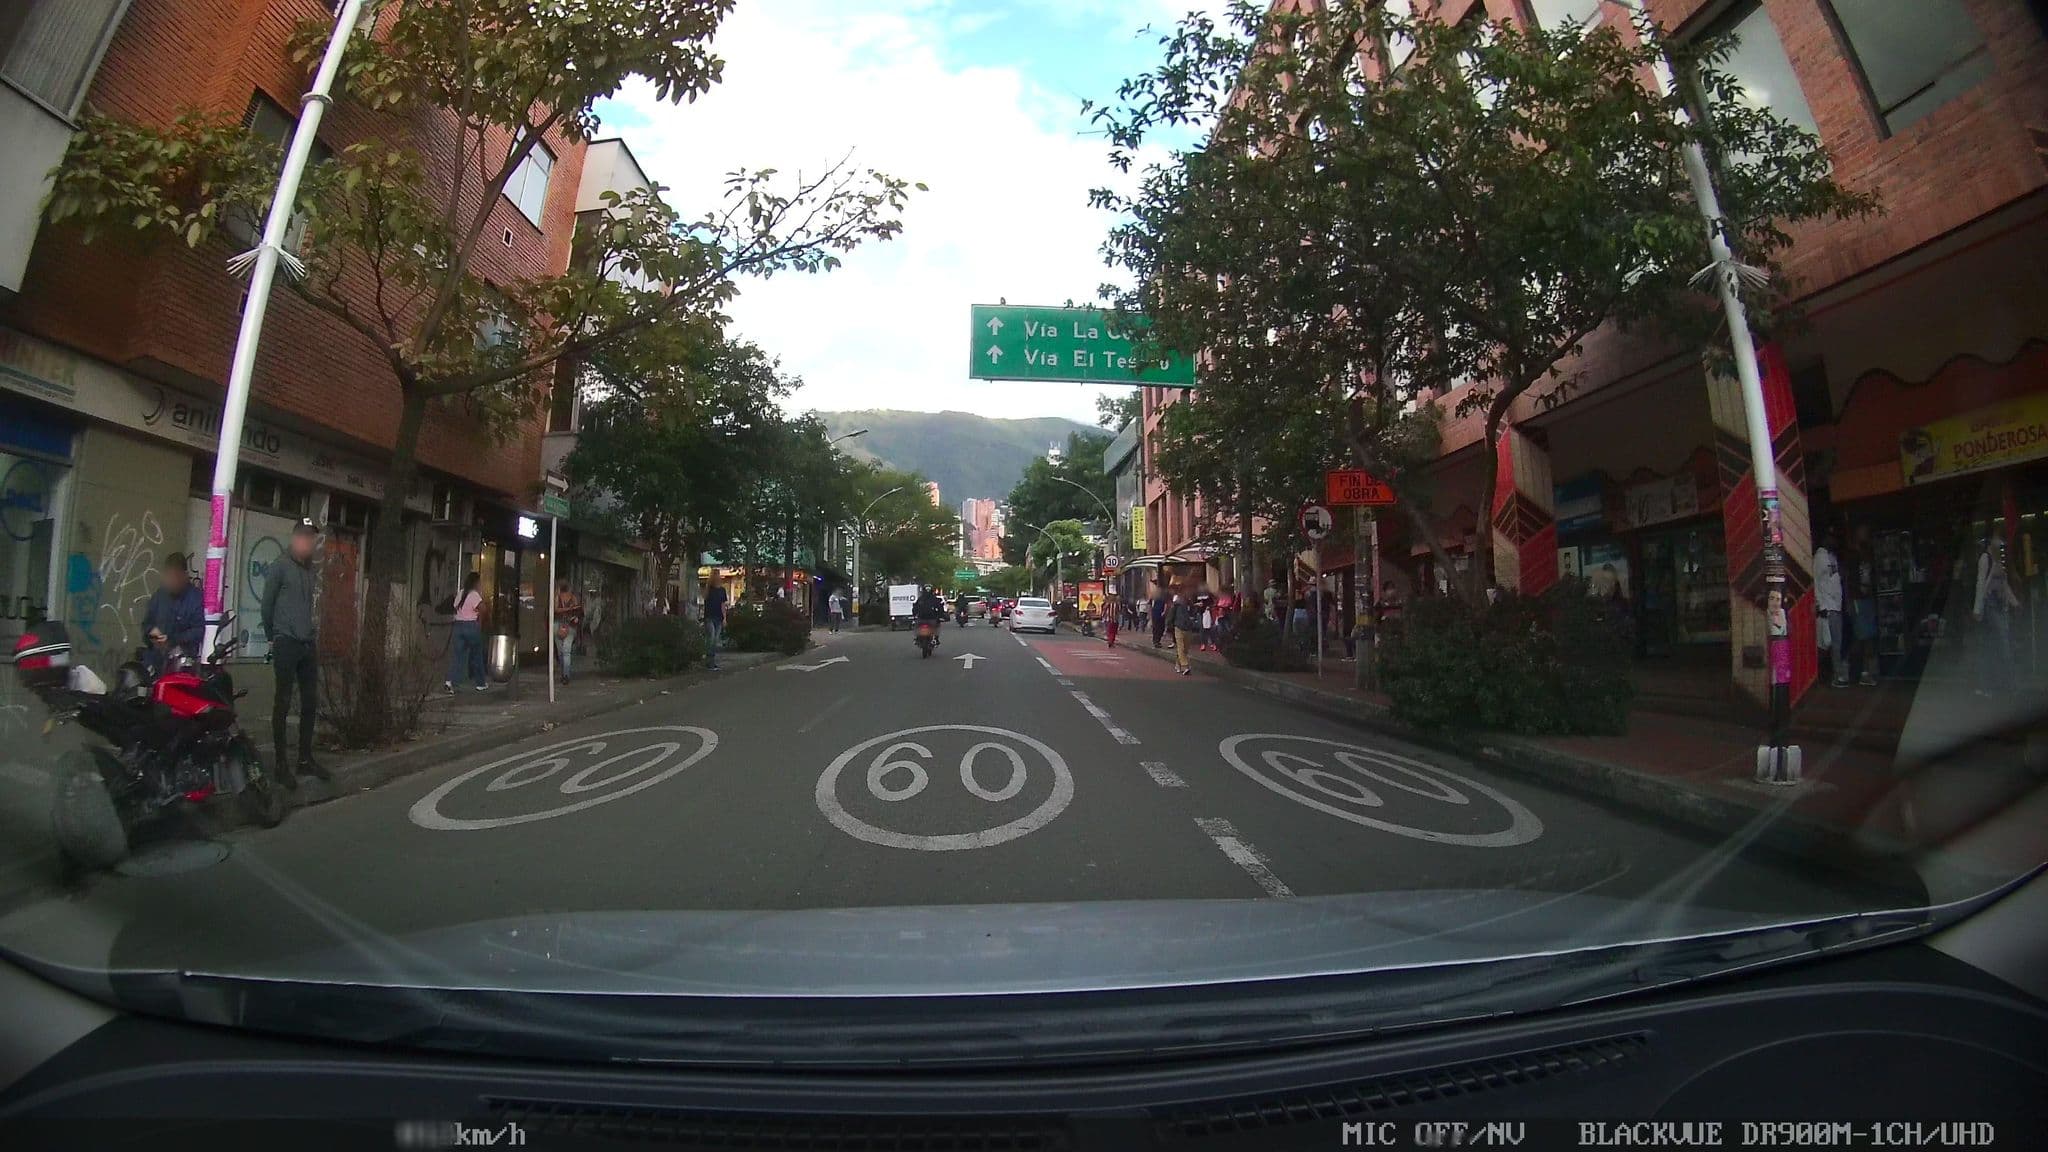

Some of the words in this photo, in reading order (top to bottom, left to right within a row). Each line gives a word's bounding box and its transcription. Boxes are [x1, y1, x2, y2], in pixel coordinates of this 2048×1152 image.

[1024, 320, 1058, 338] Vía
[1073, 321, 1099, 339] La
[1073, 350, 1094, 367] El
[1102, 350, 1170, 371] Teso
[1952, 423, 2048, 459] PONDEROSA
[1339, 474, 1361, 487] FIN
[1343, 488, 1380, 500] OBRA
[1107, 558, 1117, 566] 30
[486, 742, 681, 794] 60
[866, 741, 1028, 802] 60
[1261, 750, 1470, 808] 60
